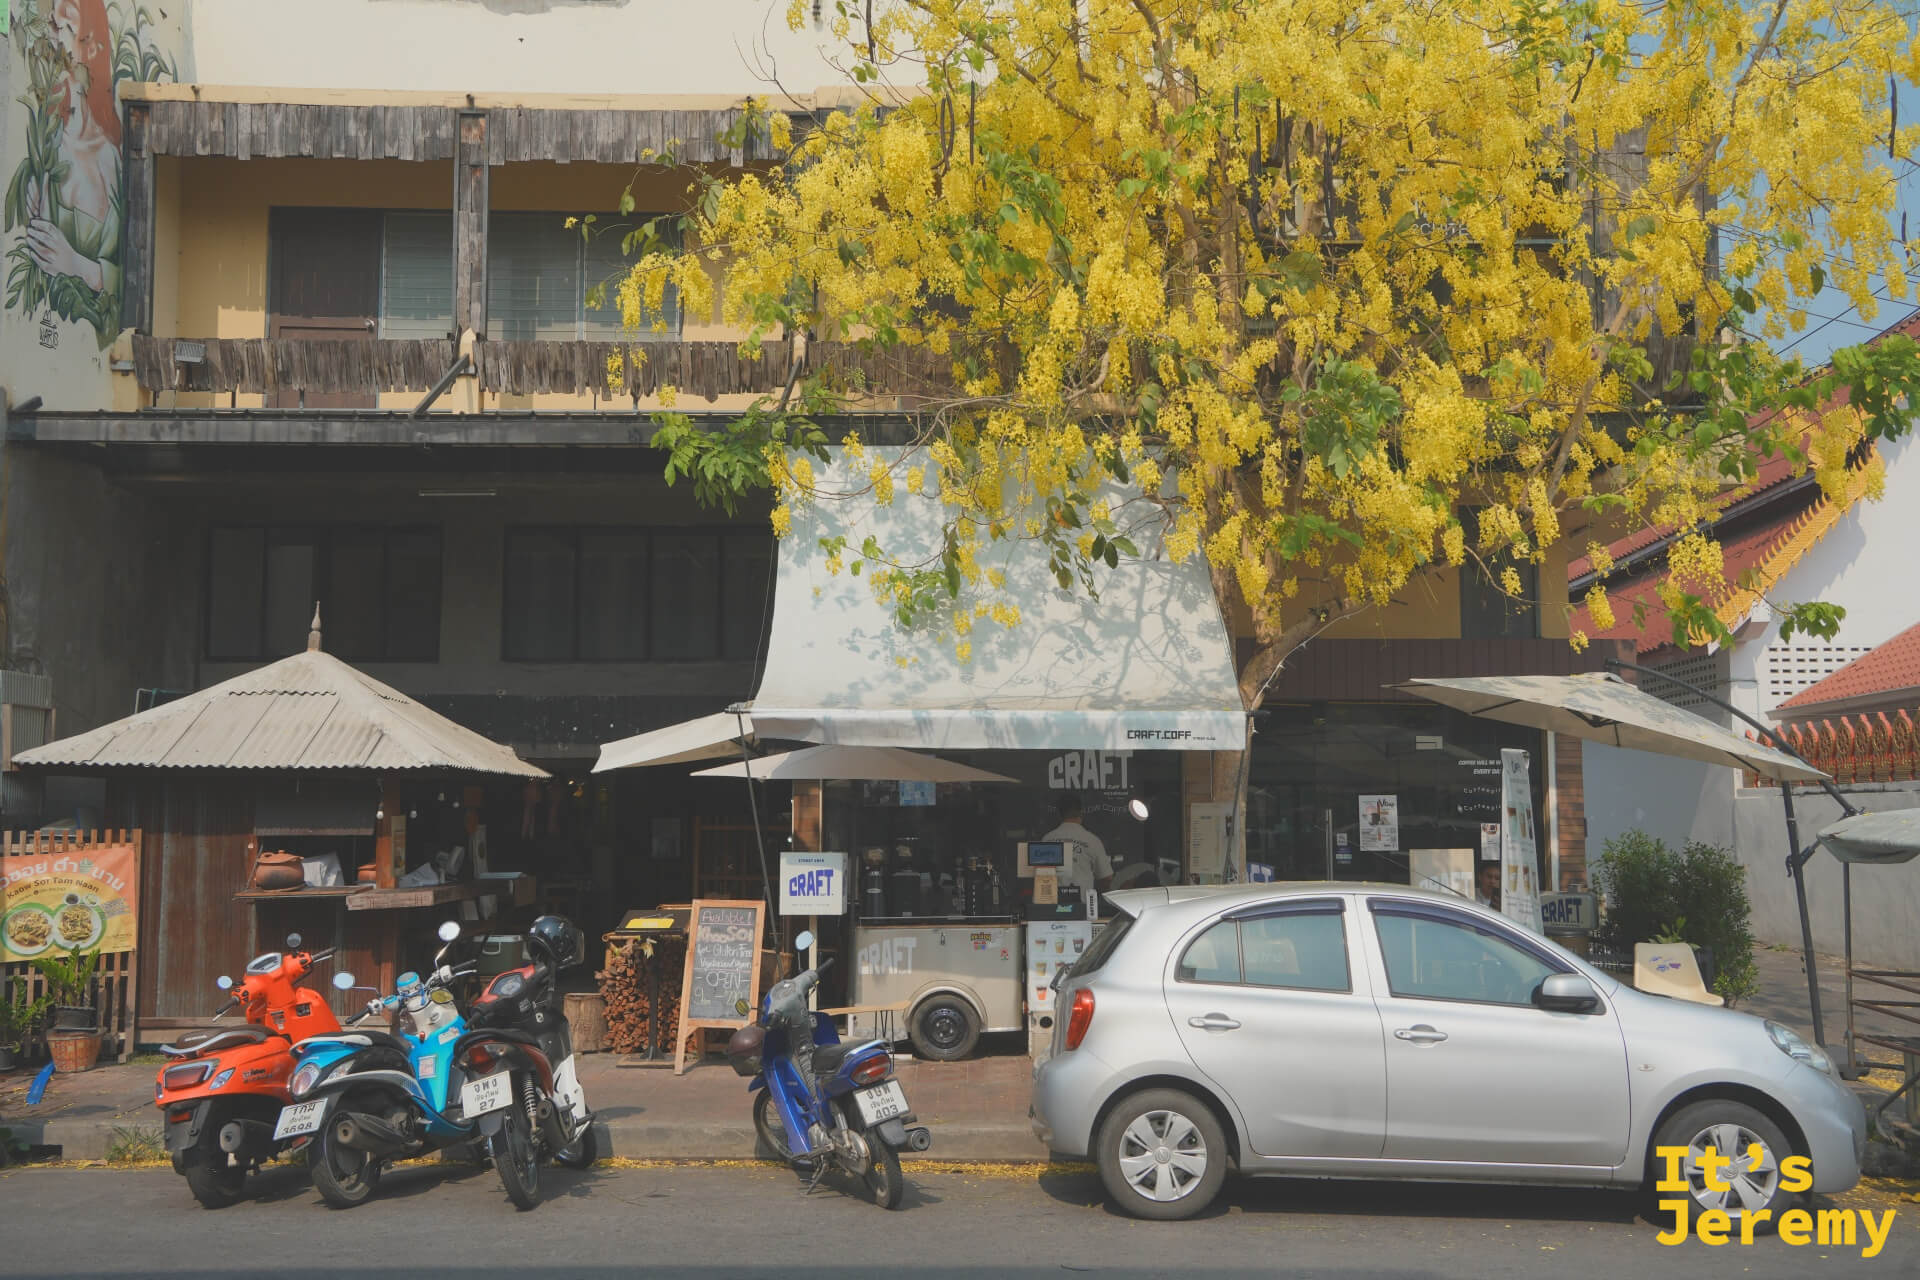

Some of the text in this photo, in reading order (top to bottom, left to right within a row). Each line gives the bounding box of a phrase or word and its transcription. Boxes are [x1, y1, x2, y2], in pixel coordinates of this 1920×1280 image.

[1127, 730, 1192, 740] CRAFT.COFF
[789, 868, 834, 897] CRAFT
[1540, 896, 1582, 923] CRAFT
[857, 936, 917, 976] CRAFT
[480, 1098, 496, 1111] 27
[876, 1104, 898, 1119] 403
